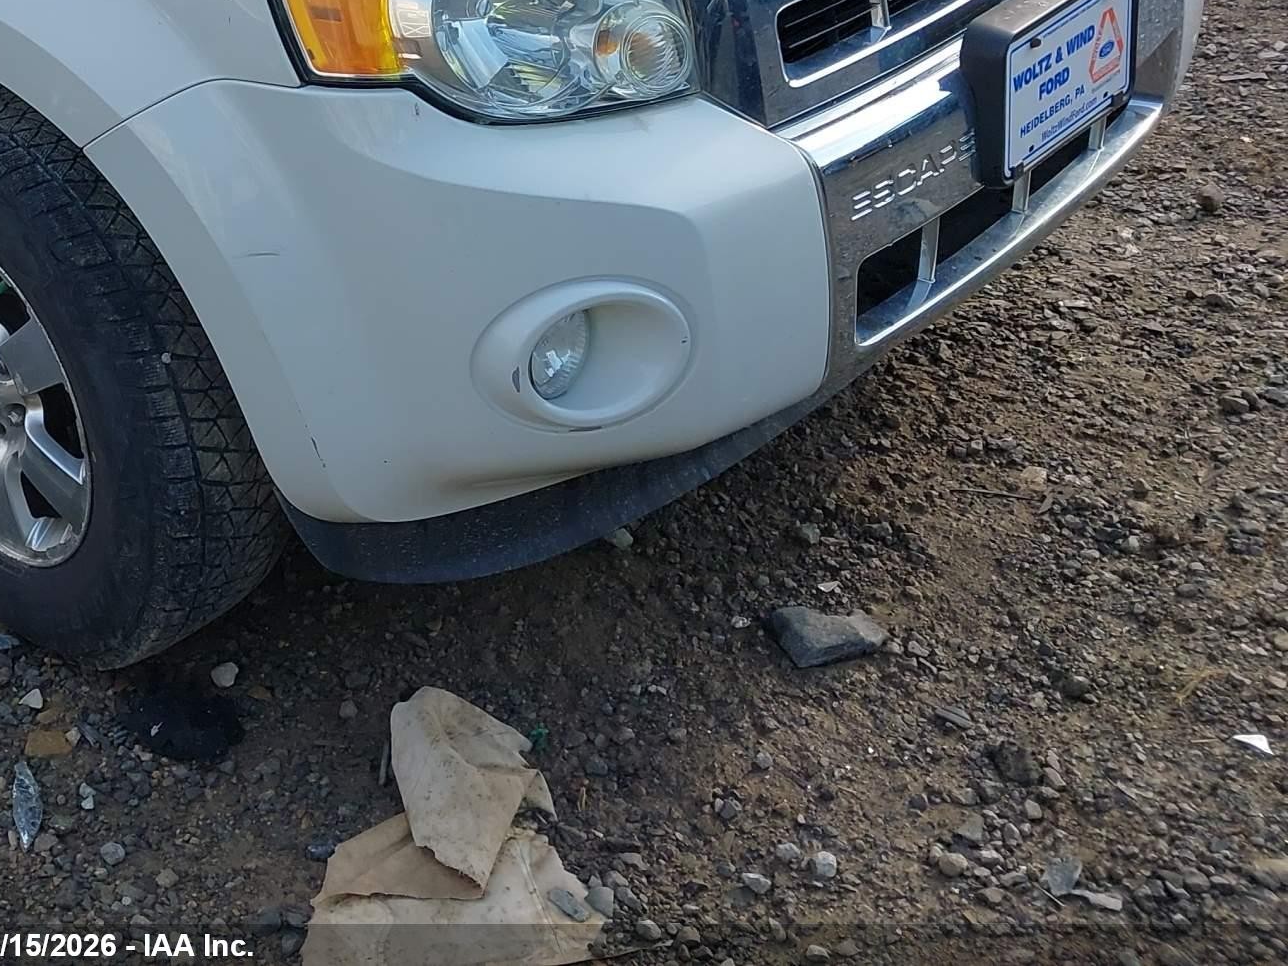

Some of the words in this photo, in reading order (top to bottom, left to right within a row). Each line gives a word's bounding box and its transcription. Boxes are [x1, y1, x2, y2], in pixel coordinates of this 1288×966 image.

[1013, 53, 1053, 92] WOLTZ
[1055, 46, 1064, 64] &
[1066, 25, 1095, 56] WIND
[1038, 66, 1070, 100] FORD
[1020, 94, 1073, 138] HEIDELBERG,
[1075, 84, 1085, 99] PA
[850, 129, 976, 221] ESCAPE
